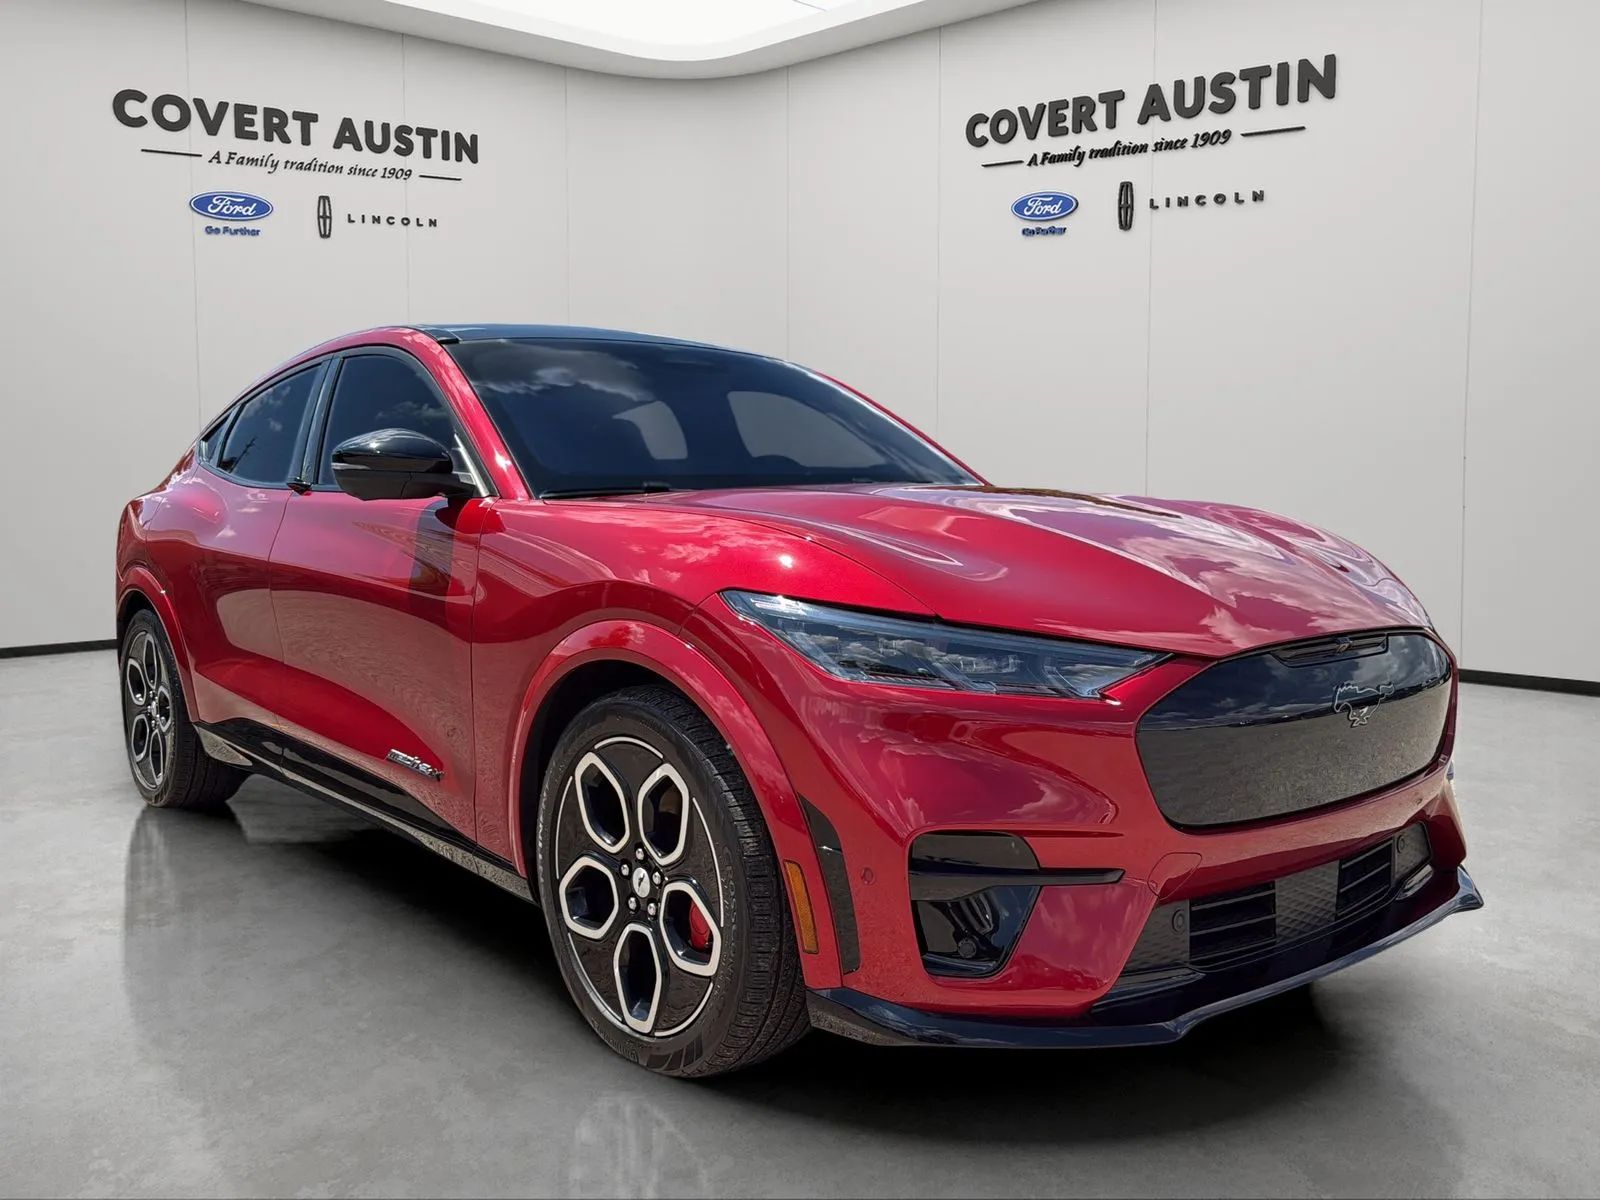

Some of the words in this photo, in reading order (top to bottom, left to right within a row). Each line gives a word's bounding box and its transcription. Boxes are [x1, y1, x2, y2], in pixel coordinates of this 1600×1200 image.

[965, 89, 1126, 149] COVERT
[1136, 53, 1337, 126] AUSTIN
[112, 88, 319, 147] COVERT
[333, 116, 479, 165] AUSTIN
[1026, 152, 1039, 168] A
[1038, 144, 1087, 168] Family
[1087, 139, 1149, 160] tradition
[1150, 136, 1189, 153] since
[1189, 128, 1233, 149] 1909
[208, 150, 222, 165] A
[224, 151, 280, 175] Family
[283, 157, 344, 175] tradition
[347, 163, 379, 178] since
[380, 166, 413, 181] 1909
[207, 195, 257, 215] Ford
[1023, 196, 1063, 216] Ford
[1149, 189, 1265, 211] LINCOLN
[347, 213, 438, 228] LINCOLN
